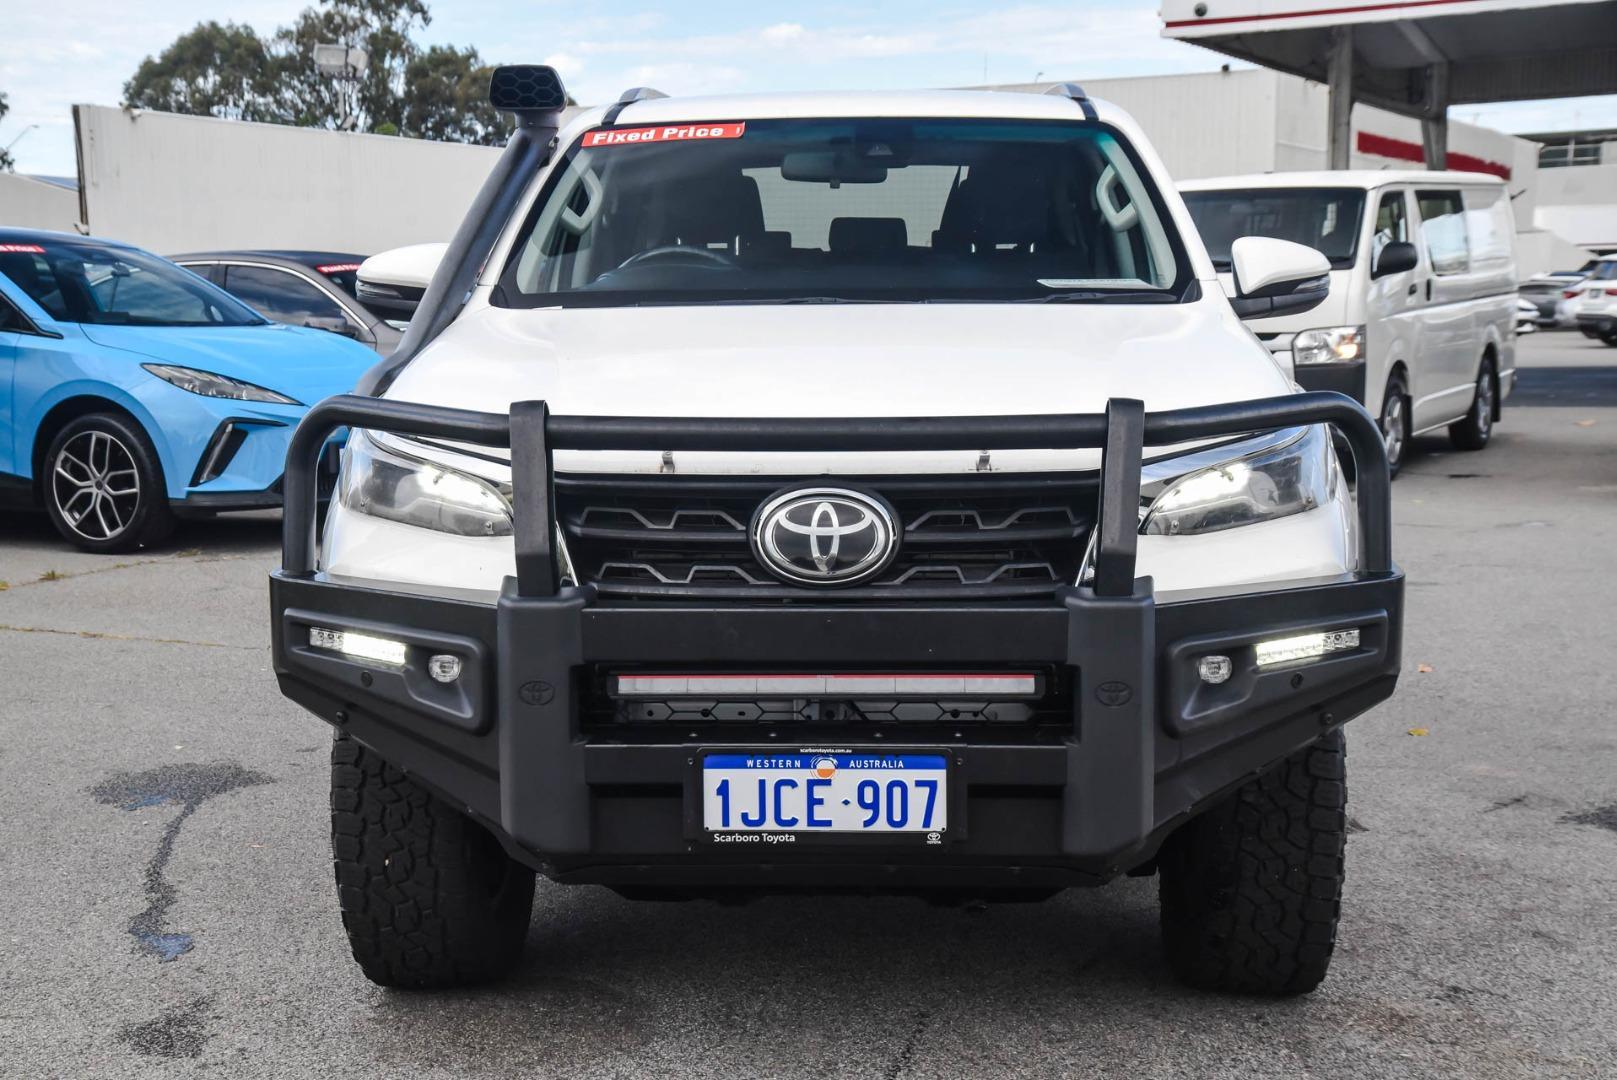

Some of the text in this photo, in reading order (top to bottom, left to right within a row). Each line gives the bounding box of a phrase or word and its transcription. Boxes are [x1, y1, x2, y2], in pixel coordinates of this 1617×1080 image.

[592, 129, 656, 145] Fixed
[662, 126, 724, 139] Price
[746, 759, 904, 769] WESTERN AUSTRALIA
[713, 833, 796, 844] Scarboro Toyota
